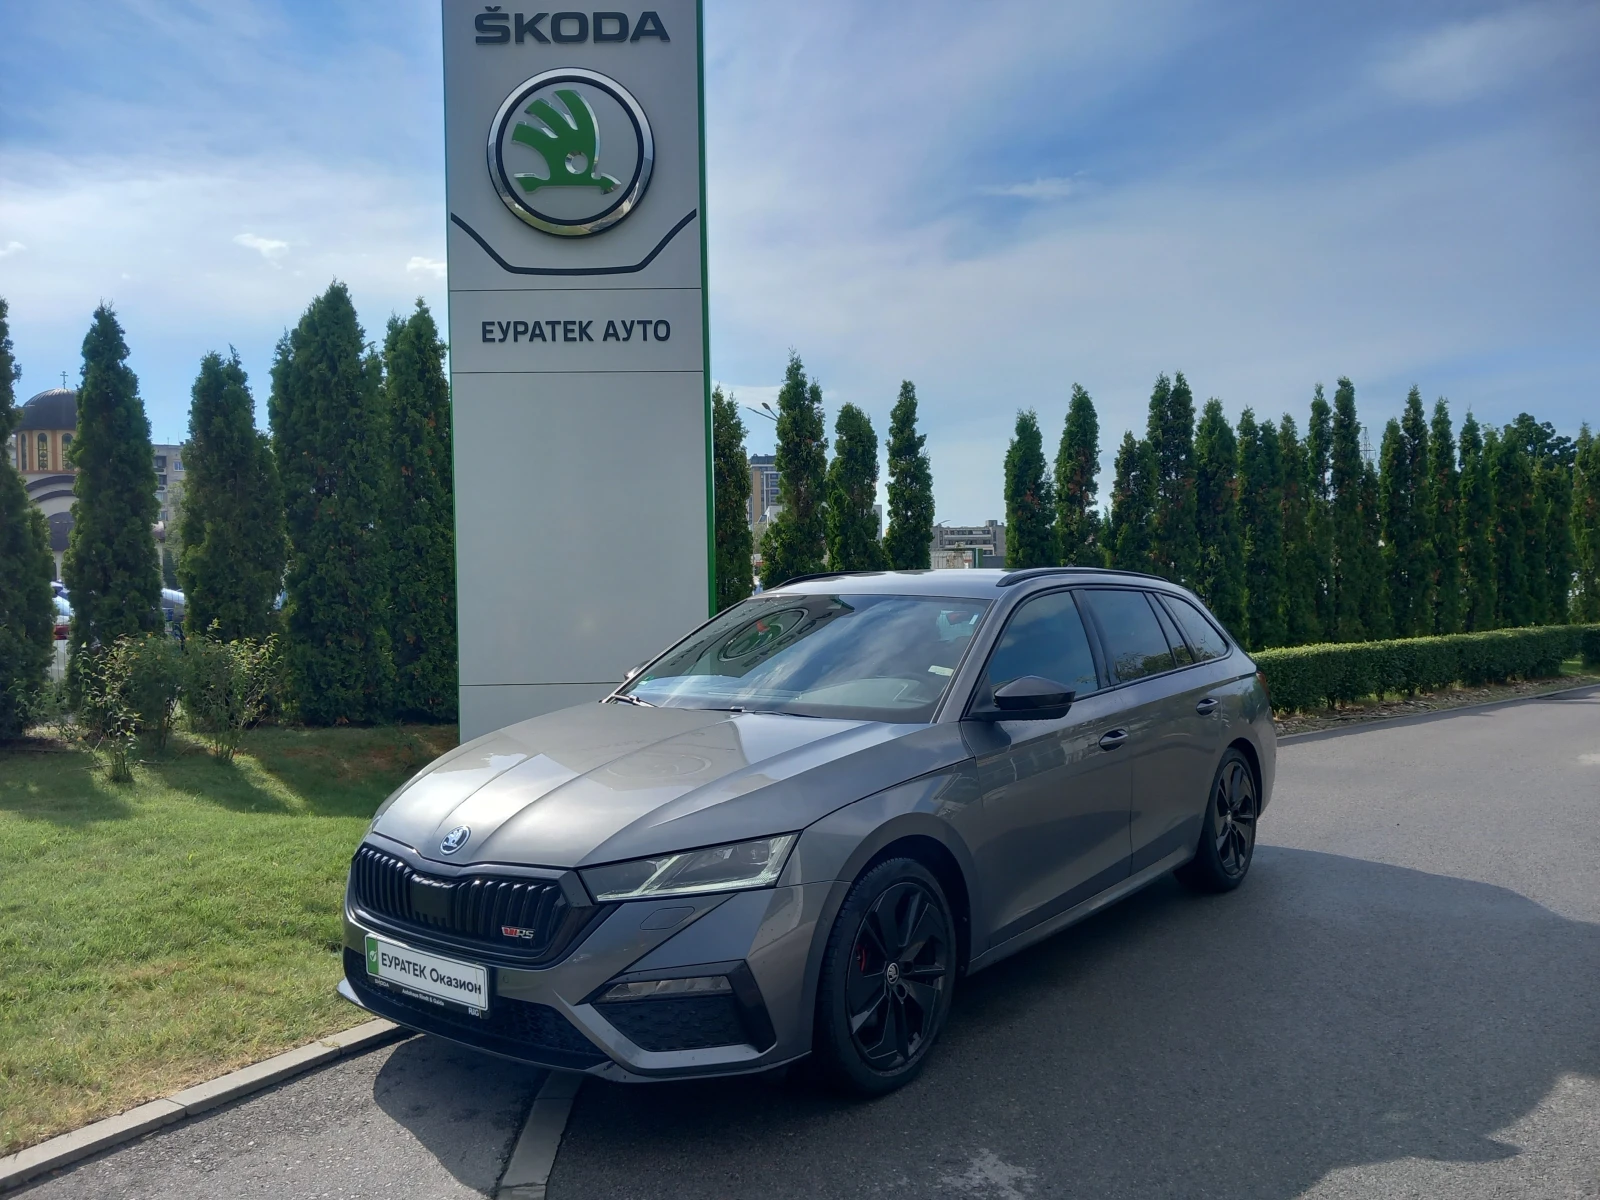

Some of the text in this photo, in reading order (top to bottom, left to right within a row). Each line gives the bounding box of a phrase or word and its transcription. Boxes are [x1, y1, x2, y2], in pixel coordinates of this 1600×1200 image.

[474, 6, 671, 45] ŠKODA
[481, 319, 671, 343] ЕУРАТЕК АУТО
[381, 952, 482, 995] ЕУРАТЕК Оказион
